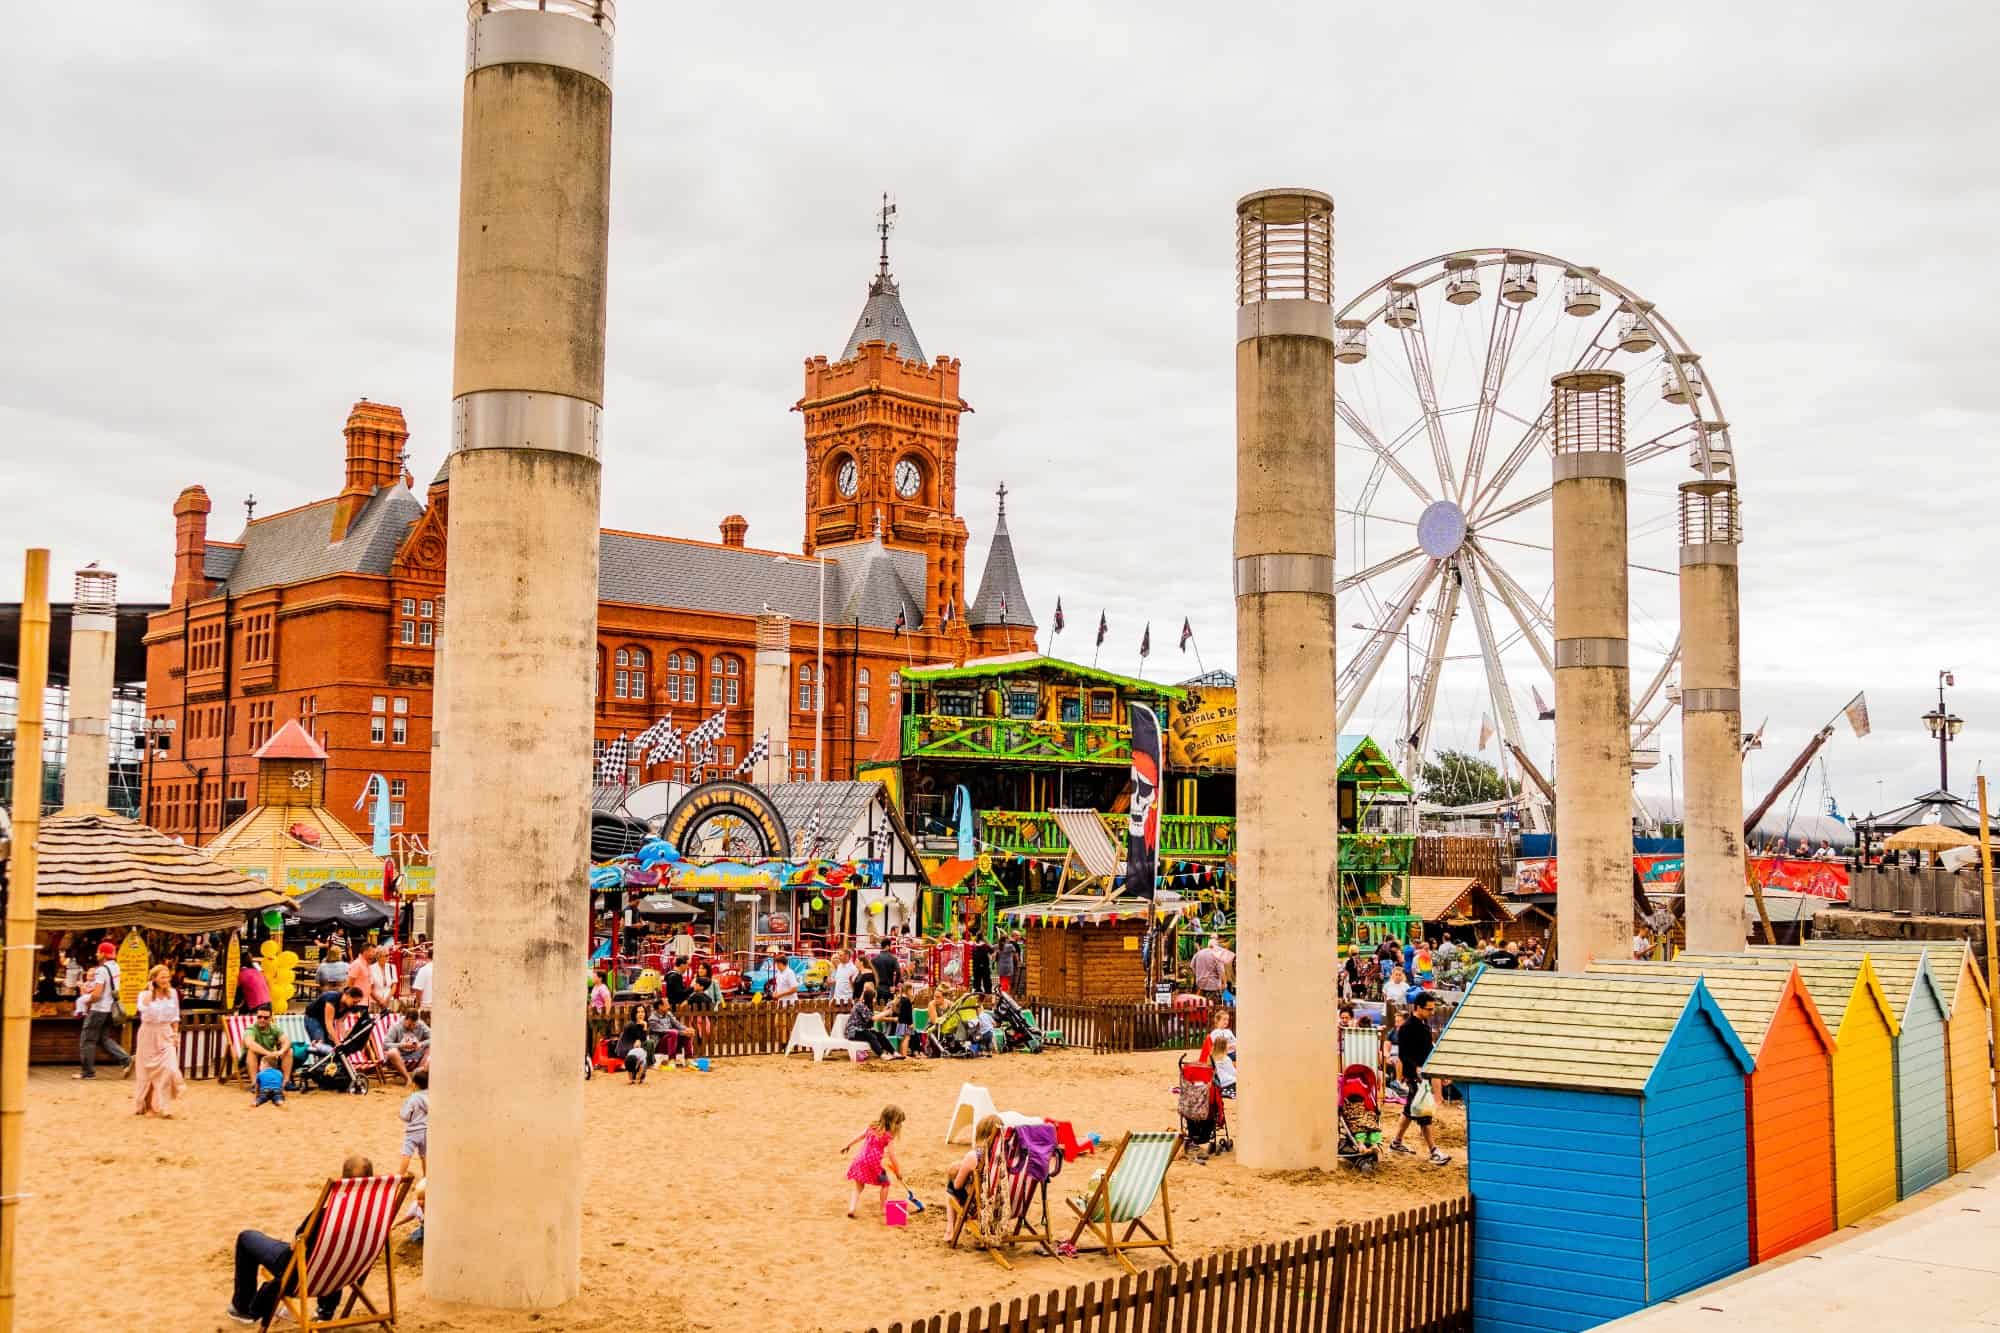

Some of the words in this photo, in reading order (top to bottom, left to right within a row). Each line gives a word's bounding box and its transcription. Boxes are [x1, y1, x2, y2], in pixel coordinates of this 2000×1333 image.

[1184, 711, 1215, 727] Pirate
[695, 794, 710, 808] TO
[711, 790, 731, 803] THE
[733, 791, 763, 817] BEACH
[762, 812, 781, 851] PARTY
